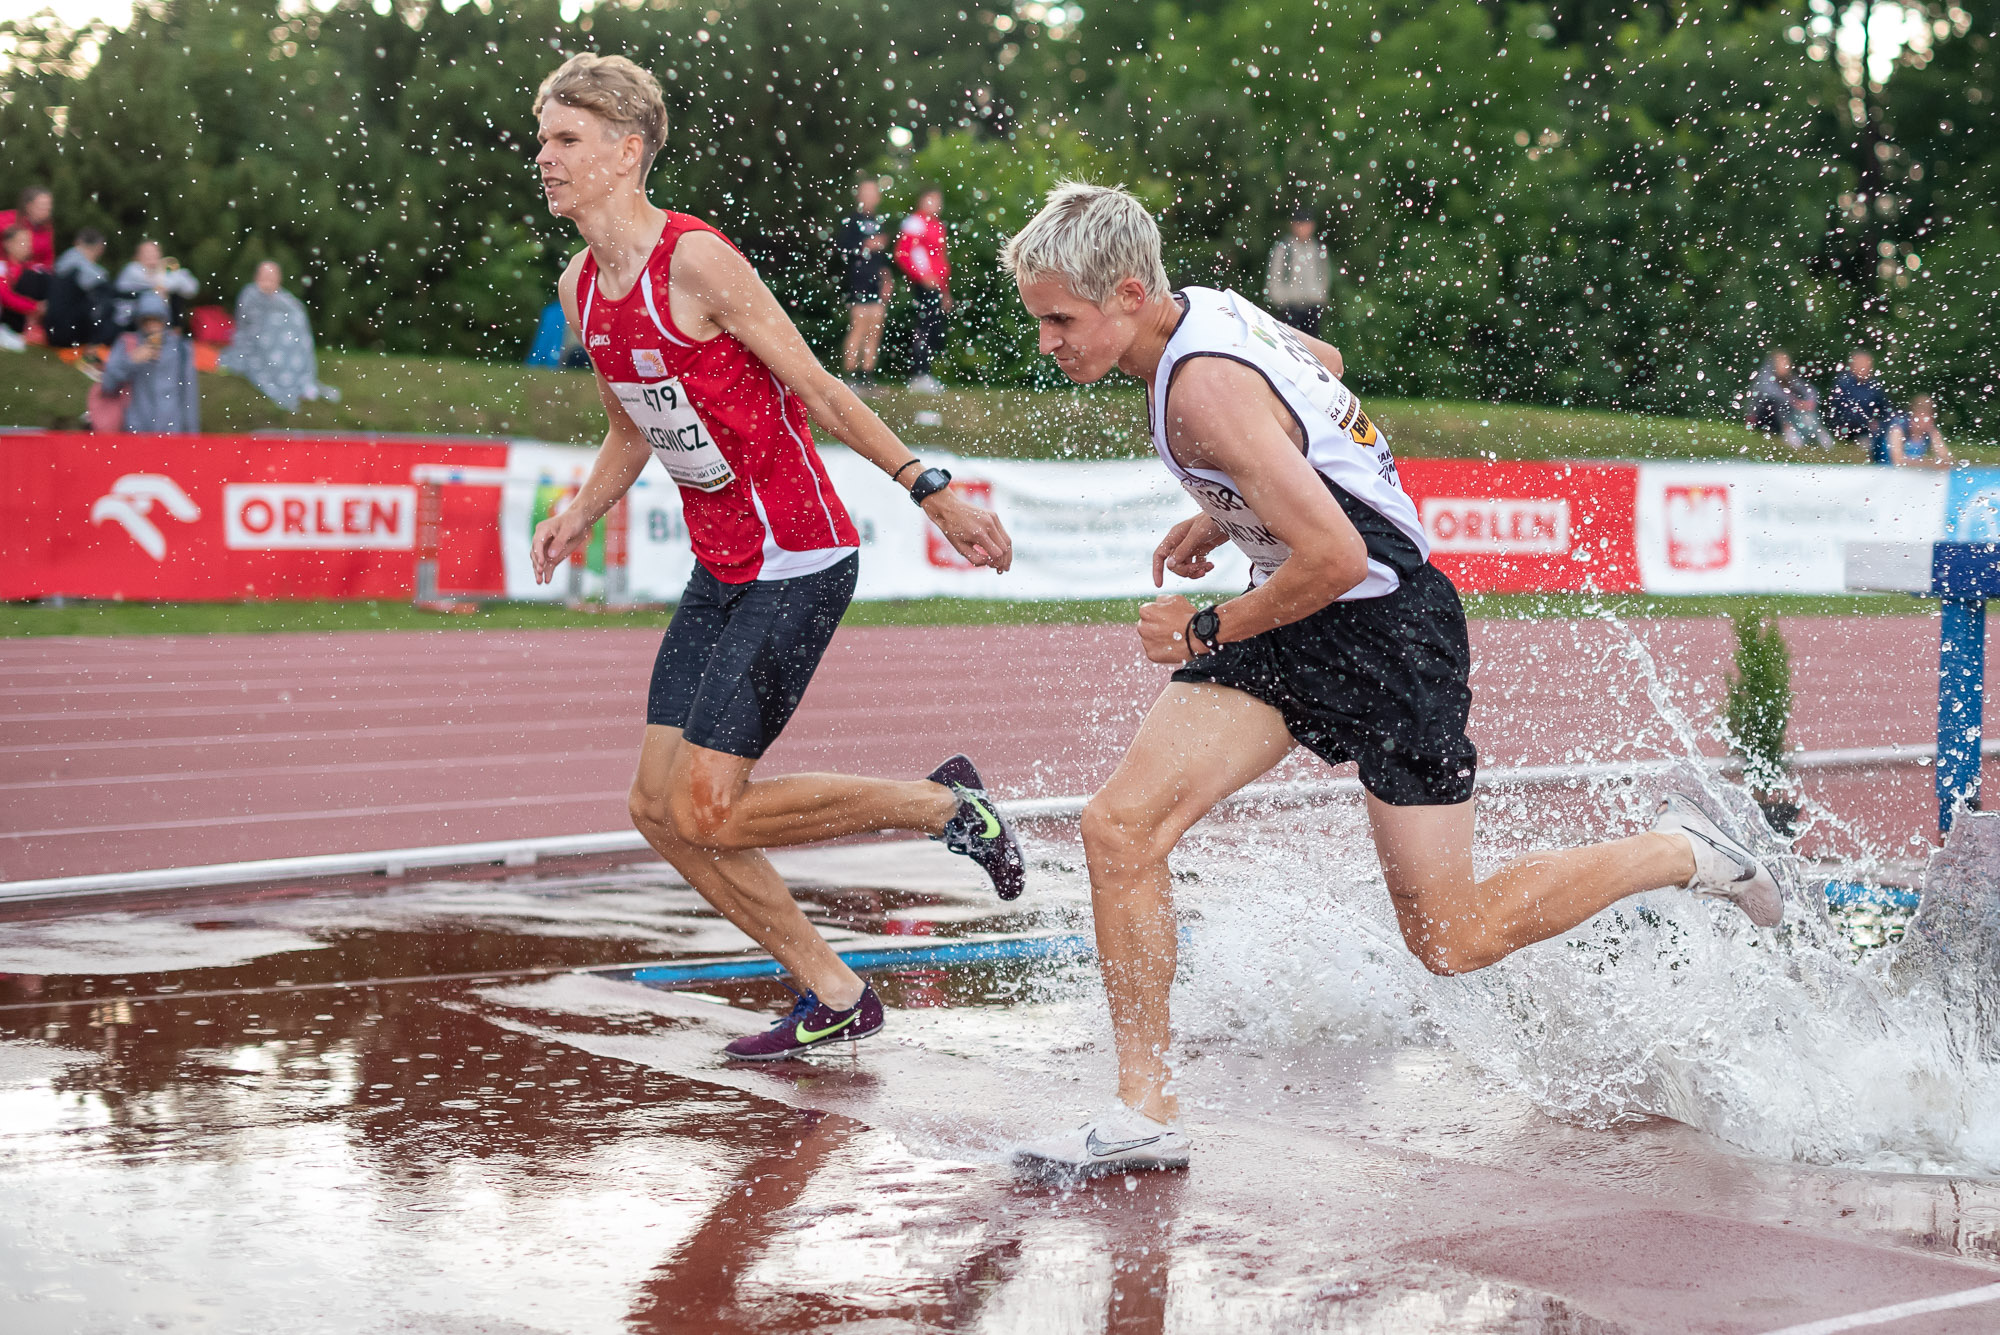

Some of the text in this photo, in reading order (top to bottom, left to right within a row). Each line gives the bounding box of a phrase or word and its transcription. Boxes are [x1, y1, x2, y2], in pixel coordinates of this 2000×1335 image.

[642, 386, 678, 412] 479
[241, 499, 398, 535] ORLEN
[1433, 510, 1556, 540] ORLEN
